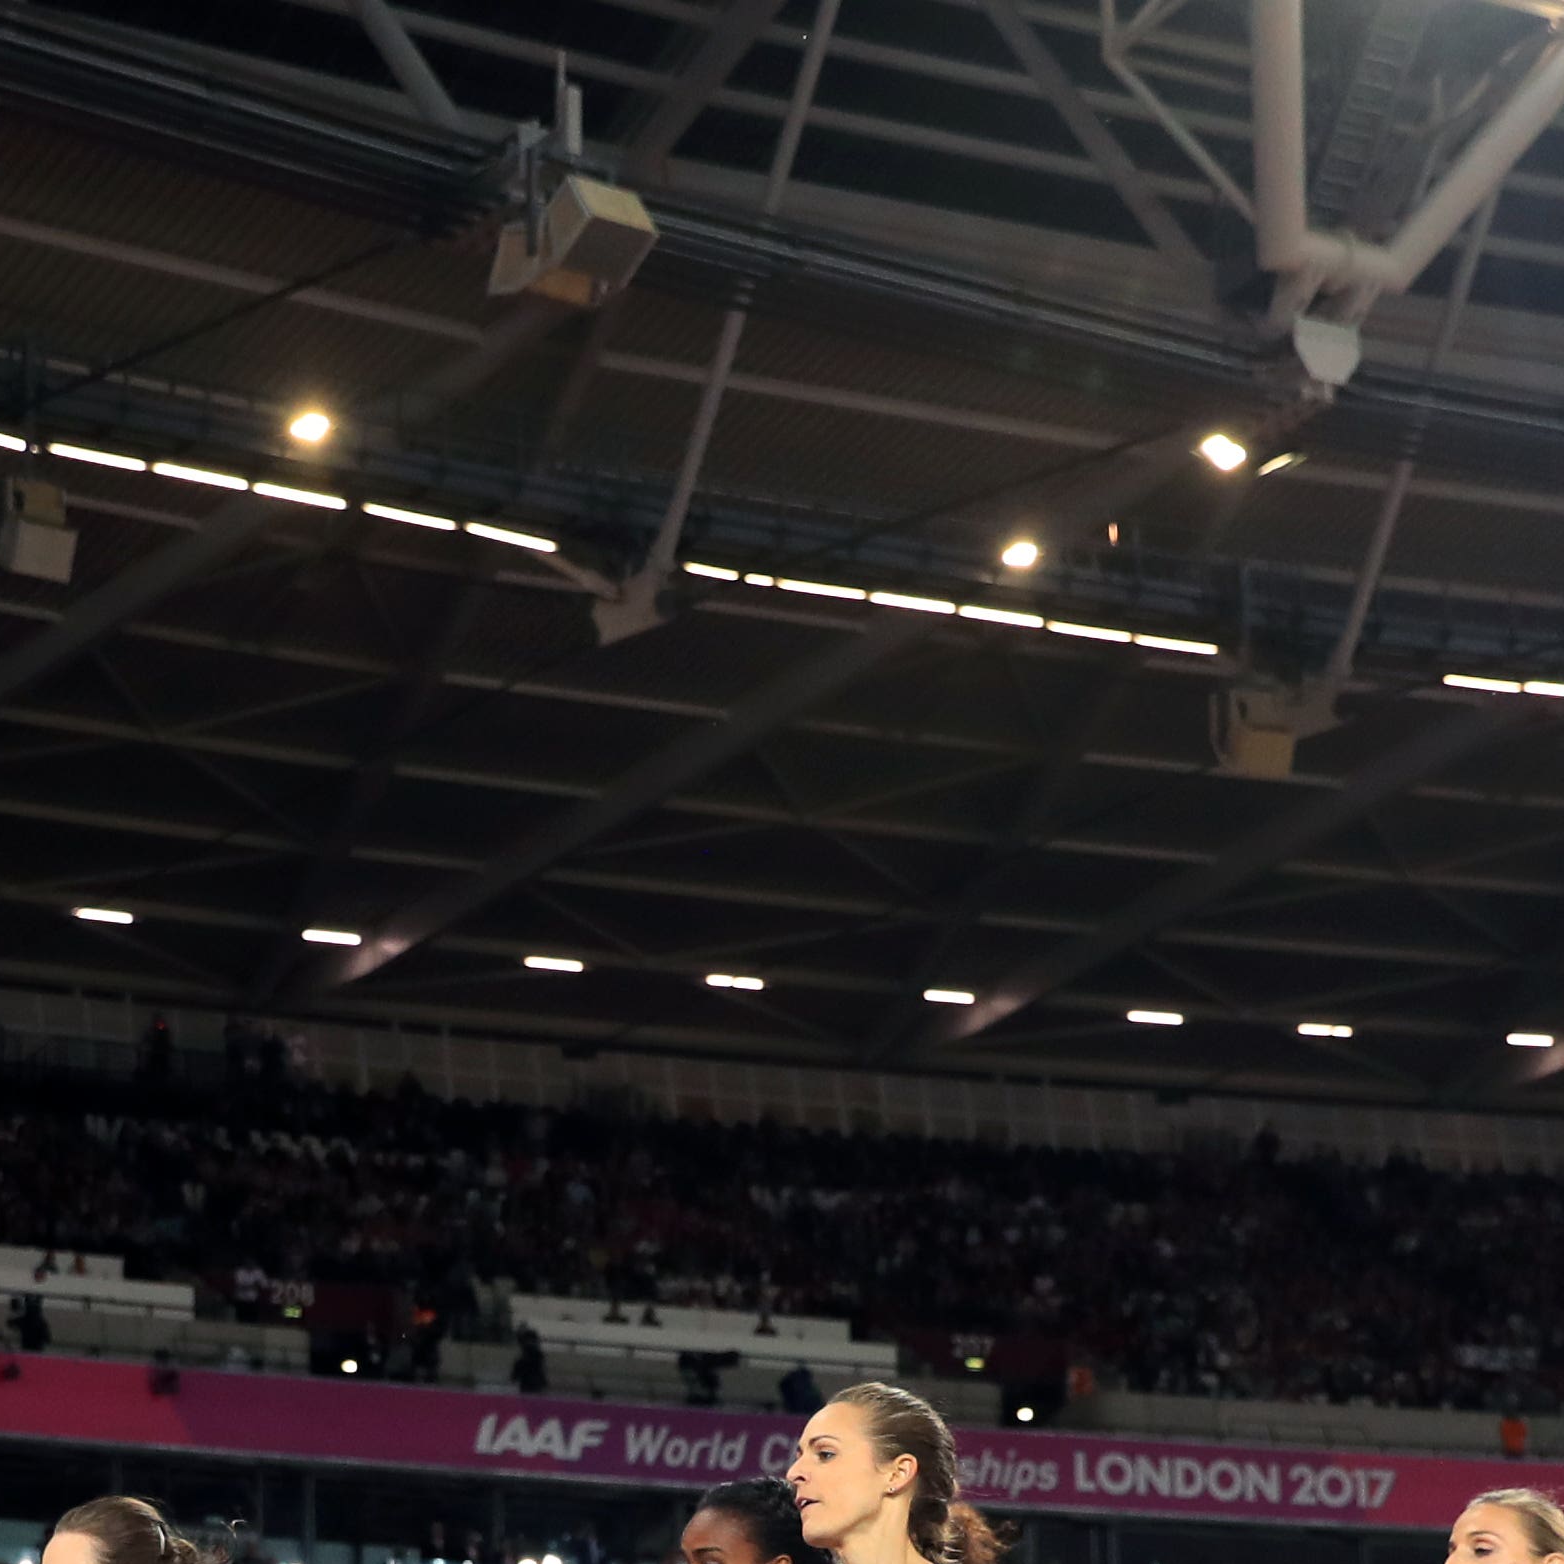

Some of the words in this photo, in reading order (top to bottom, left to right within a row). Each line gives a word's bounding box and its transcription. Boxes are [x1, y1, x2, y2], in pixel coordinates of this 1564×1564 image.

[476, 1415, 609, 1460] IAAF
[623, 1424, 746, 1471] World
[1073, 1451, 1281, 1503] LONDON
[1288, 1465, 1396, 1508] 2017
